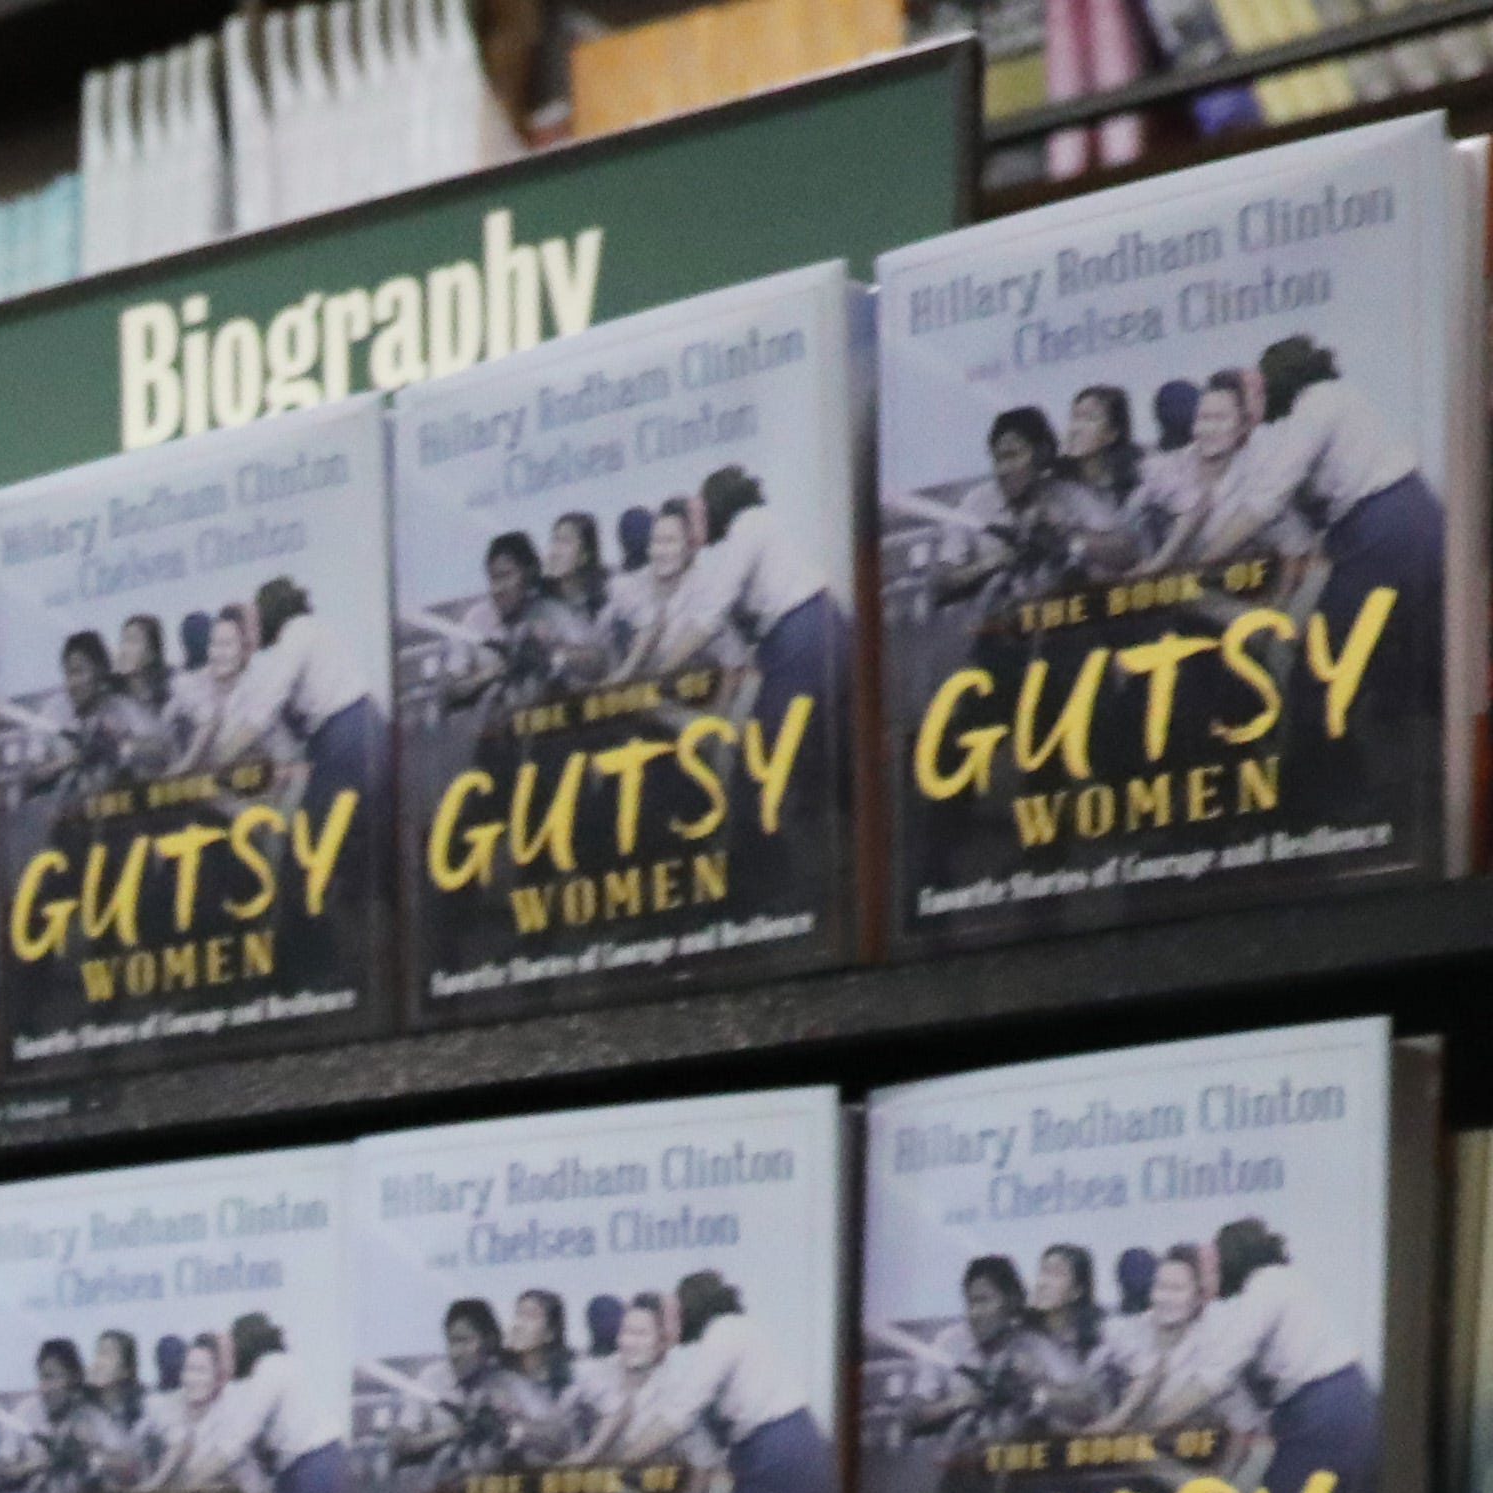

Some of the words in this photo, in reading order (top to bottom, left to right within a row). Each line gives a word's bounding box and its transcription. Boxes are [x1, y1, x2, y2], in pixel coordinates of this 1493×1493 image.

[910, 267, 1047, 336] Hillary
[1063, 219, 1228, 295] Rodham
[1246, 175, 1397, 246] Clinton
[119, 209, 603, 453] Biography
[1017, 302, 1167, 370] Chelsea
[1184, 260, 1334, 329] Clinton
[915, 589, 1395, 796] GUTSY
[429, 695, 814, 889] GUTSY
[1012, 755, 1282, 848] WOMEN
[9, 791, 354, 959] GUTSY
[511, 846, 729, 935] WOMEN
[80, 928, 276, 1003] WOMEN
[893, 1123, 1020, 1175] Hillary
[1034, 1100, 1185, 1155] Rodham
[1202, 1077, 1338, 1133] Clinton
[379, 1174, 497, 1222] Hillary
[510, 1152, 652, 1205] Rodham
[668, 1132, 799, 1185] Clinton
[990, 1168, 1128, 1221] Chelsea
[1144, 1147, 1280, 1202] Clinton
[470, 1217, 598, 1267] Chelsea
[613, 1199, 742, 1251] Clinton
